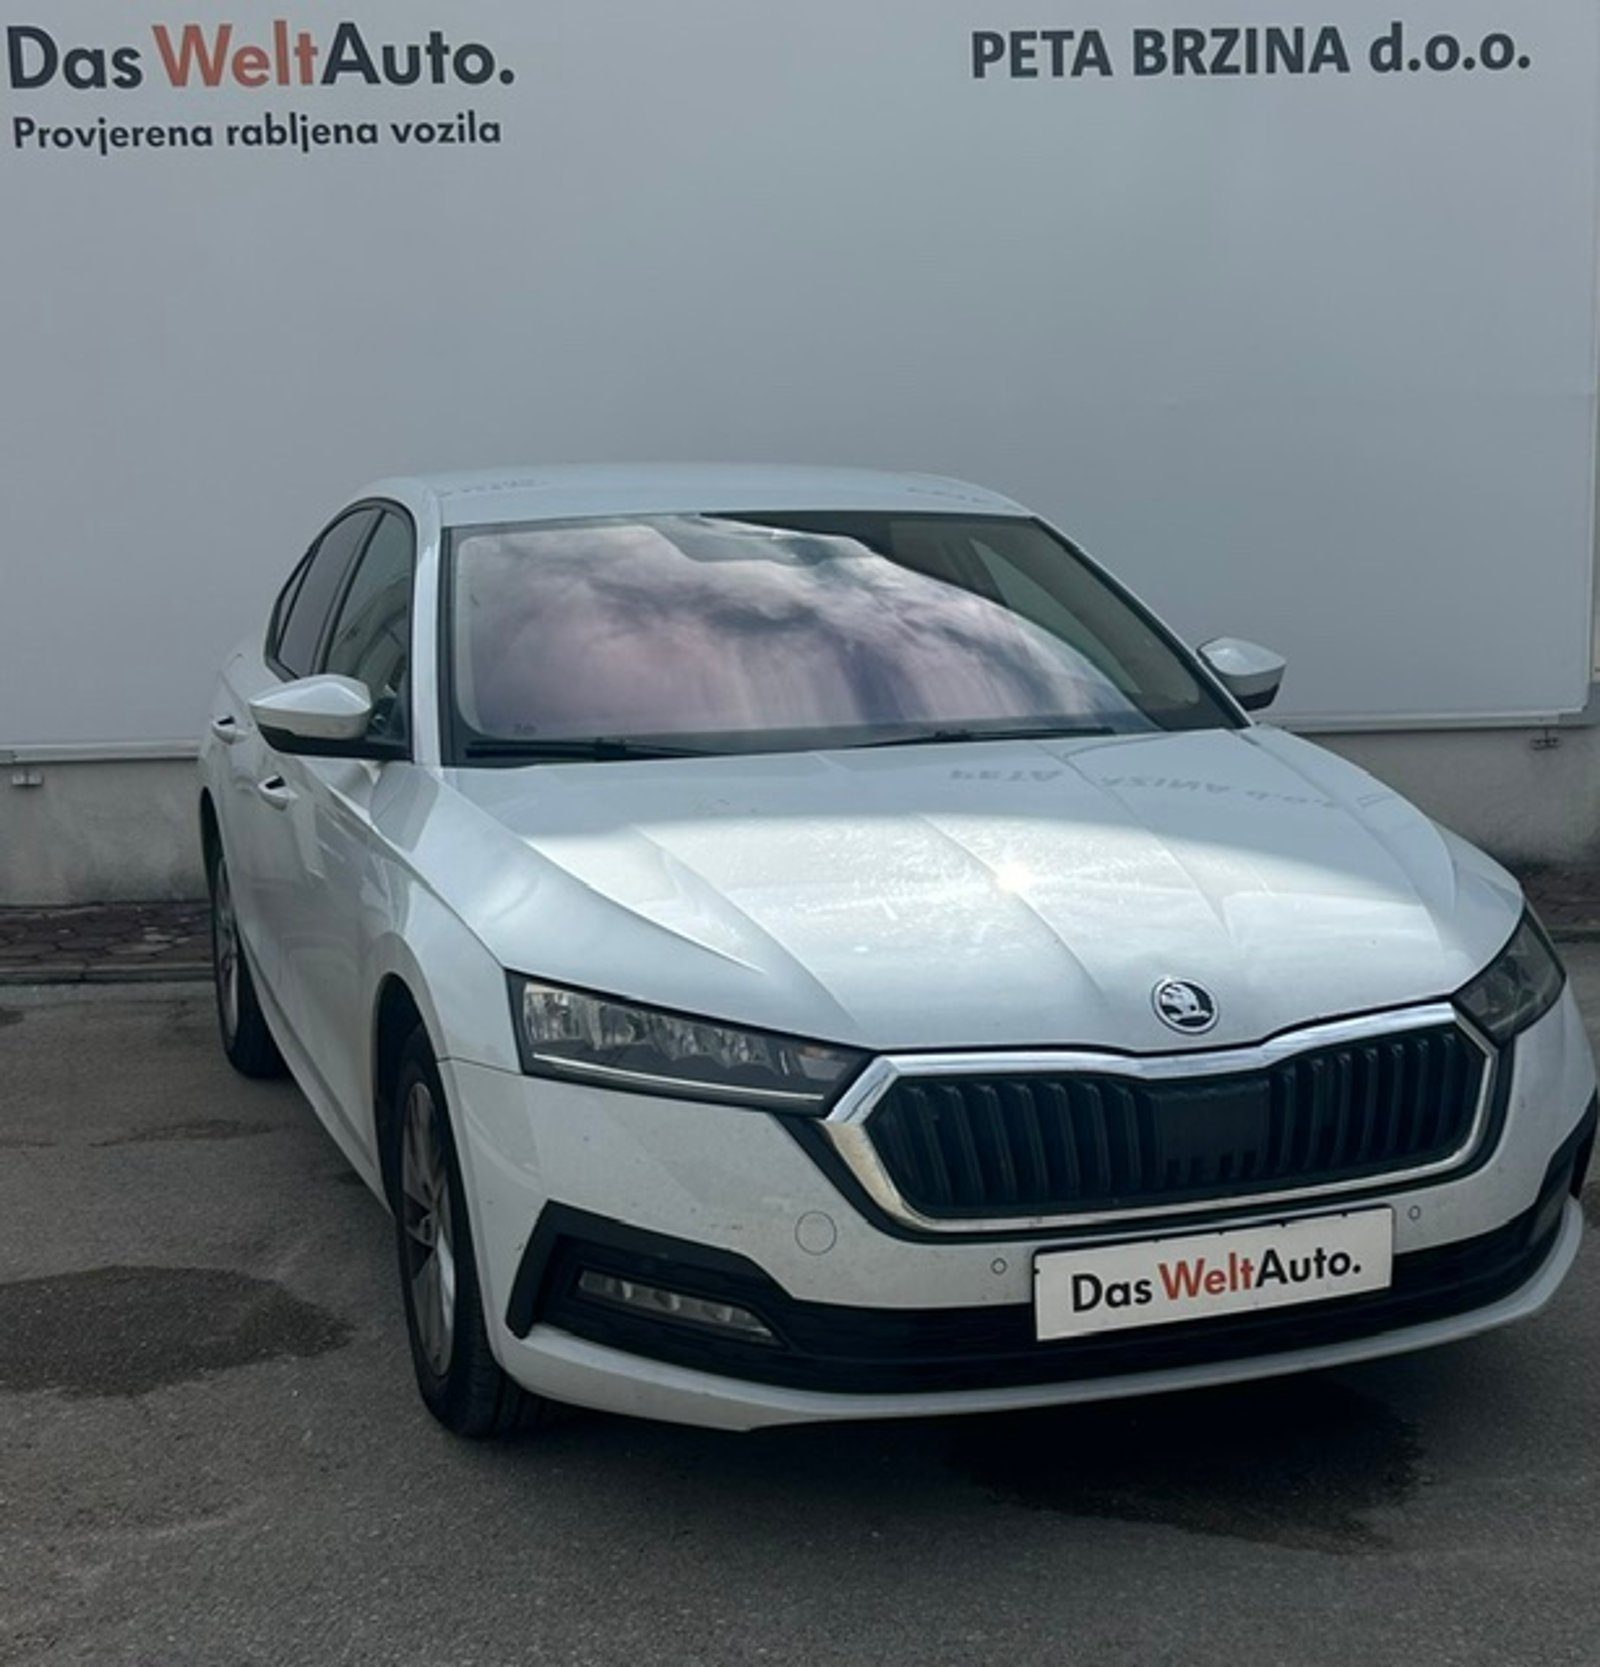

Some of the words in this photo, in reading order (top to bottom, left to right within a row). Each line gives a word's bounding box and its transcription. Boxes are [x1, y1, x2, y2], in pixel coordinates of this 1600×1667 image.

[7, 25, 143, 89] Das
[151, 20, 515, 87] WeltAuto.
[971, 30, 1113, 79] PETA
[1133, 26, 1351, 76] BRZINA
[1369, 22, 1531, 73] d.o.o.
[13, 117, 213, 156] Provjerena
[226, 112, 379, 153] rabljena
[391, 110, 501, 144] vozila
[1071, 1273, 1153, 1313] Das
[1158, 1248, 1362, 1300] WeltAuto.
